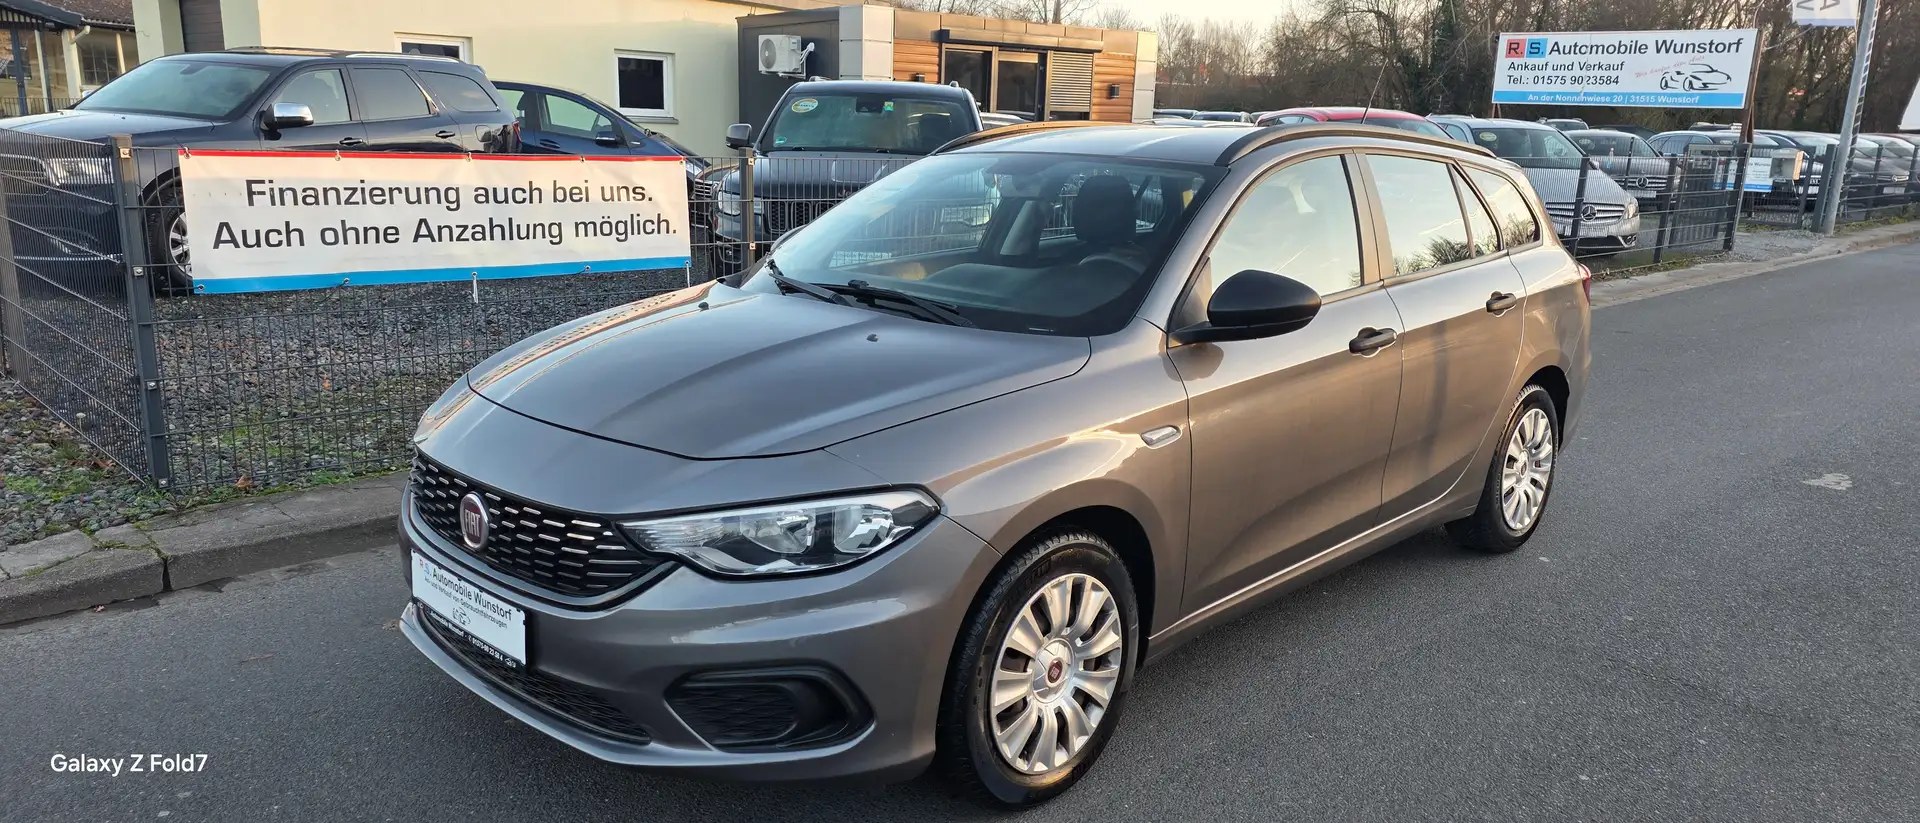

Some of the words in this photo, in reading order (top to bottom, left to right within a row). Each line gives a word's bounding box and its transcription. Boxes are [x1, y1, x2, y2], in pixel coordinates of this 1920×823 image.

[1548, 39, 1648, 55] Automobile
[1655, 38, 1744, 54] Wunstorf
[1508, 61, 1549, 71] Ankauf
[1552, 61, 1574, 71] und
[1578, 61, 1625, 71] Verkauf
[1507, 75, 1529, 85] Tel.:
[1533, 75, 1566, 85] 01575
[1570, 75, 1620, 86] 9023584
[1630, 95, 1655, 103] 31515
[1657, 95, 1699, 104] Wunstorf
[246, 179, 460, 212] Finanzierung
[473, 180, 542, 205] auch
[553, 180, 589, 203] bei
[601, 184, 653, 202] uns.
[213, 220, 305, 249] Auch
[320, 219, 400, 245] ohne
[412, 216, 563, 246] Anzahlung
[574, 213, 677, 243] möglich.
[465, 509, 480, 537] FIAT
[433, 567, 472, 600] Automobile
[473, 590, 512, 621] Wunstorf
